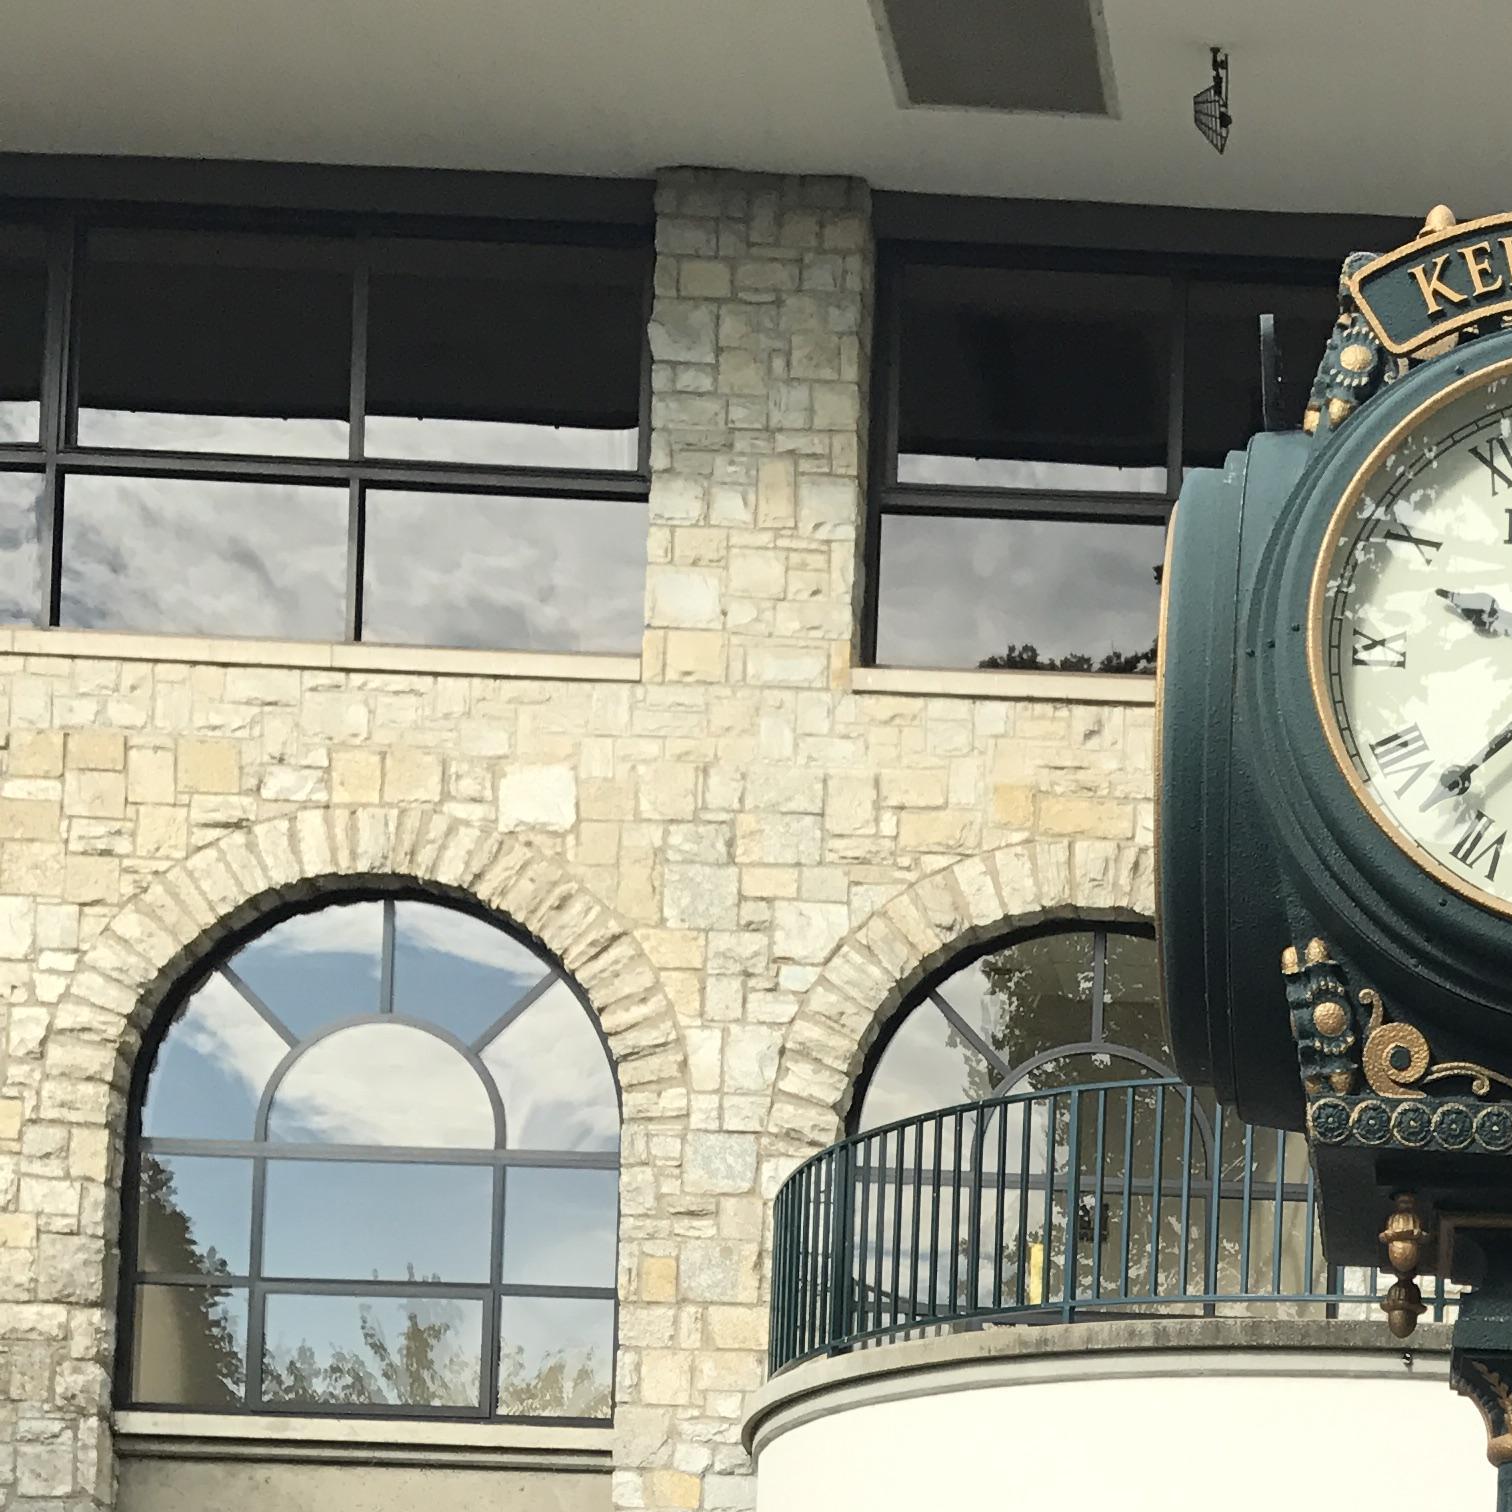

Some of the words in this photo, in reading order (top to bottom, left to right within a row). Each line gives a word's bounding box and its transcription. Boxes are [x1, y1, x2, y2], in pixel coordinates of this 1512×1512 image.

[1384, 518, 1443, 566] X
[1352, 629, 1407, 669] IX
[1369, 722, 1436, 799] VIII
[1449, 809, 1507, 882] VII
